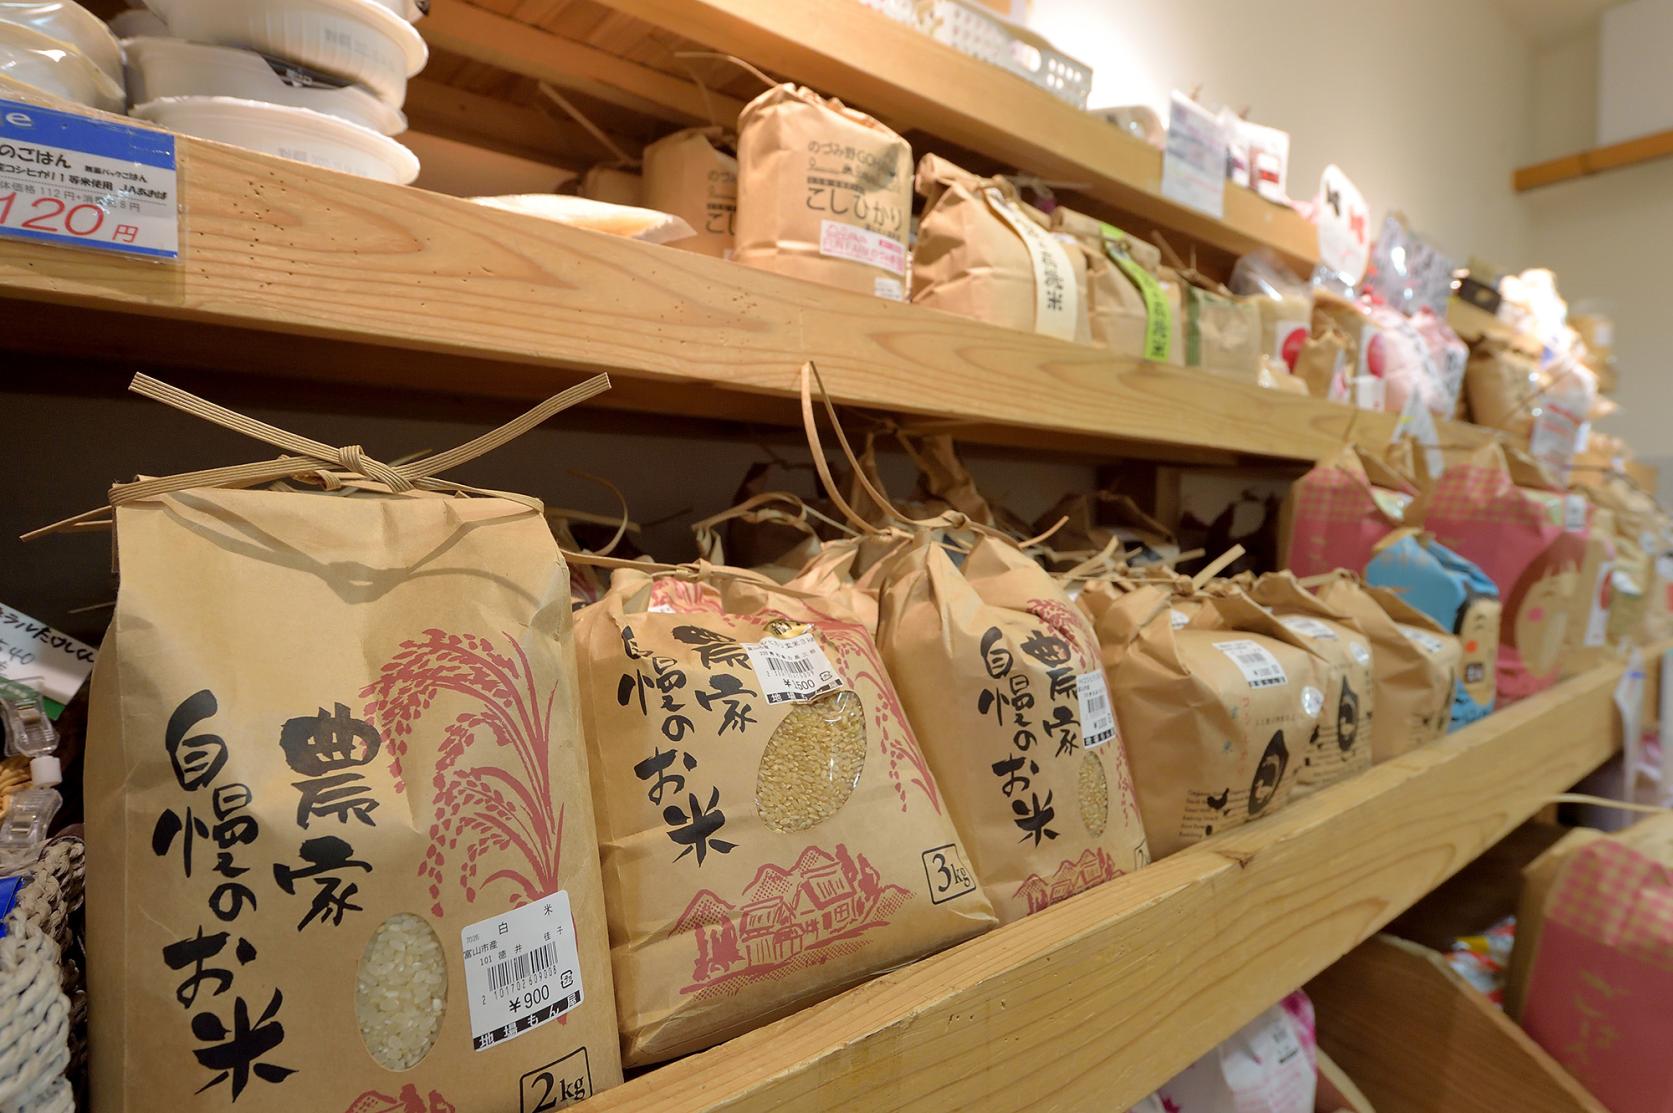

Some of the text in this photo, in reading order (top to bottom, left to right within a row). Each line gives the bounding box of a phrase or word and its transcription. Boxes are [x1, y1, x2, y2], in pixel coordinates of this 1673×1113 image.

[806, 186, 902, 232] こしひかり
[1020, 629, 1081, 758] 農家
[978, 626, 1060, 847] 自慢のお米
[273, 702, 380, 932] 農家
[152, 689, 299, 1102] 自慢のお米
[935, 852, 972, 894] 3kg
[463, 939, 498, 960] 富山市産
[480, 954, 492, 966] 101
[531, 1072, 586, 1113] 2kg
